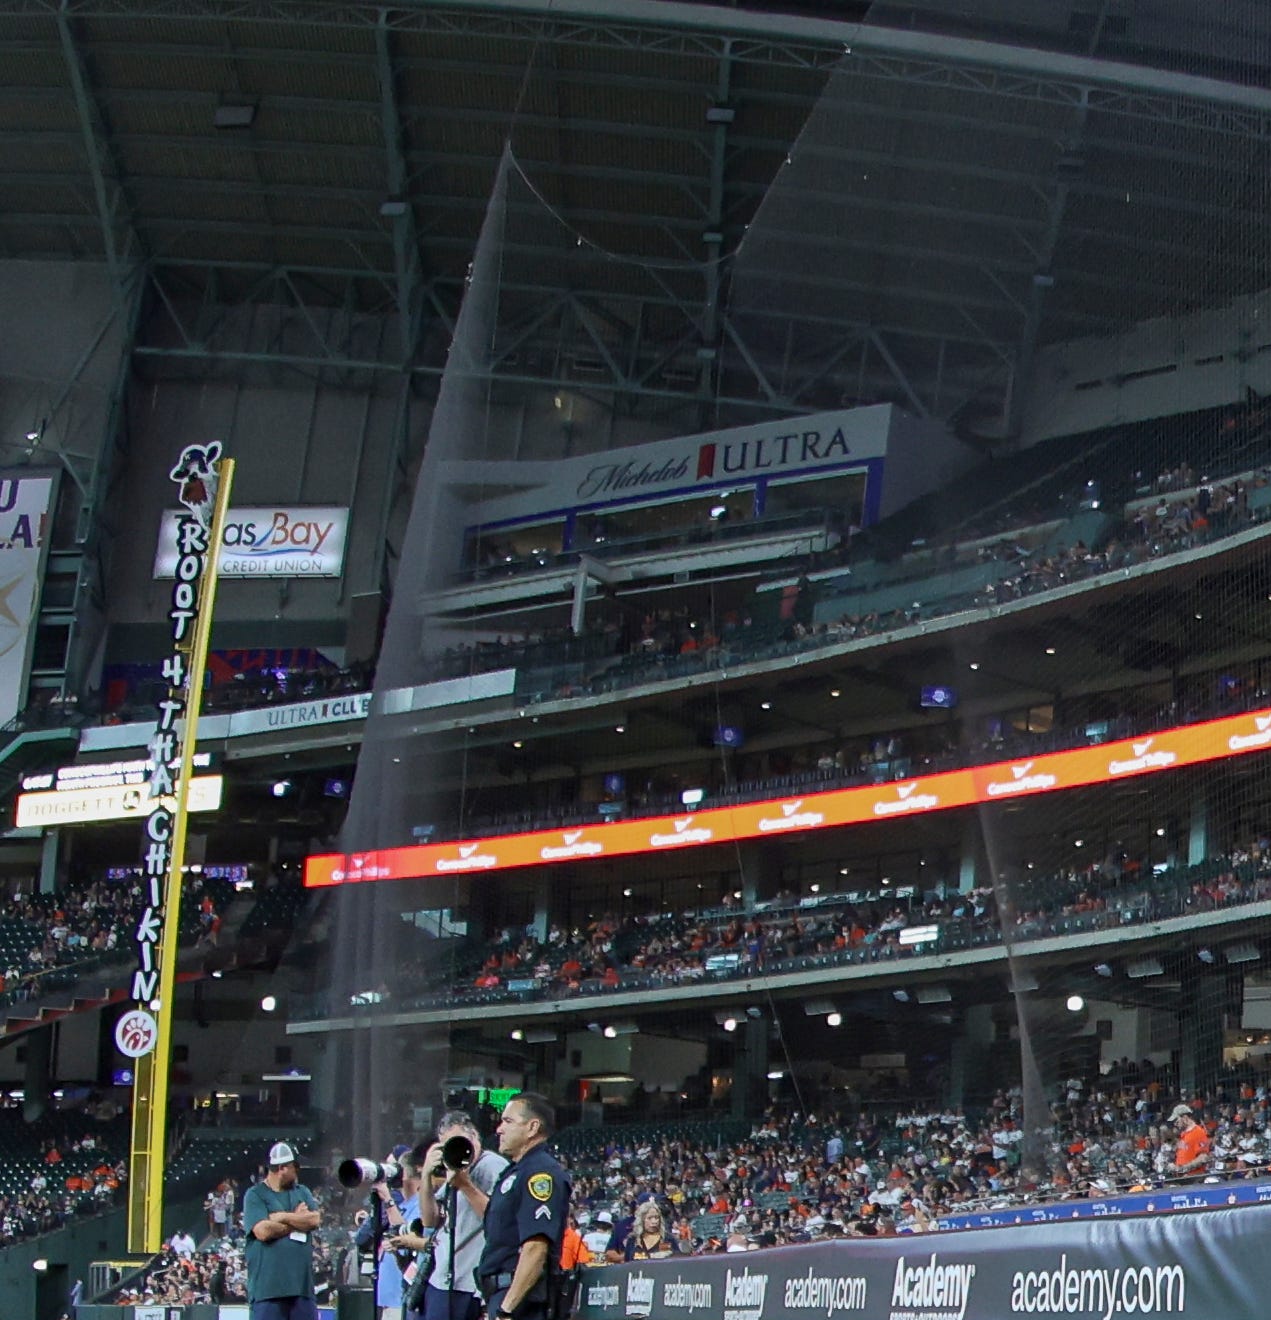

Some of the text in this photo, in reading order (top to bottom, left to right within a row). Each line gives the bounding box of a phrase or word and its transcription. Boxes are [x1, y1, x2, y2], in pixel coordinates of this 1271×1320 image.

[577, 427, 850, 499] Michelob ULTRA
[271, 512, 334, 556] Bay
[170, 524, 207, 641] ROOT
[223, 558, 322, 573] CREDIT UNION
[163, 654, 184, 687] 4
[268, 706, 318, 726] ULTRA
[664, 1275, 712, 1313] academy.com
[784, 1266, 867, 1318] academy.com
